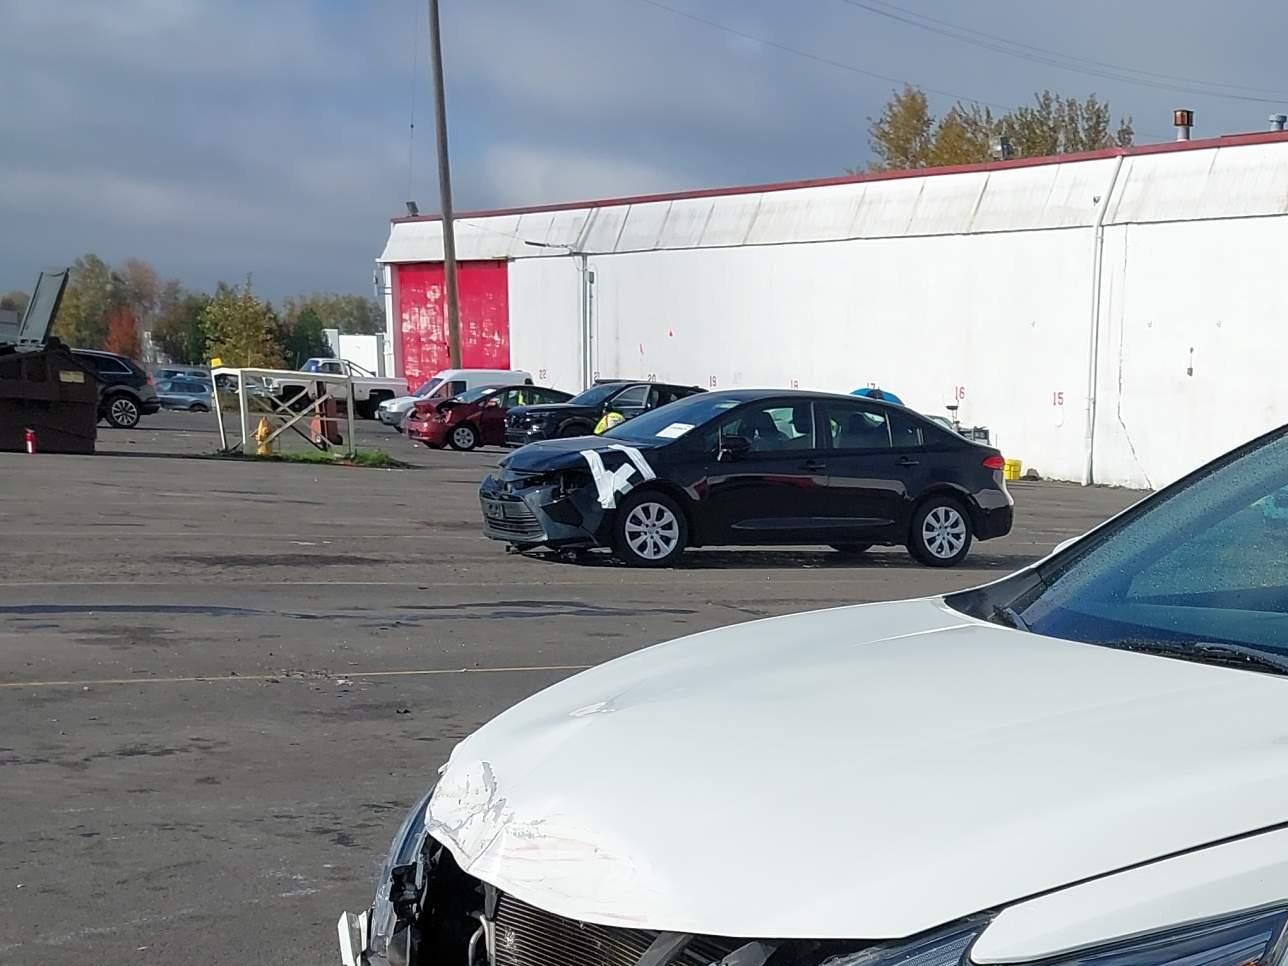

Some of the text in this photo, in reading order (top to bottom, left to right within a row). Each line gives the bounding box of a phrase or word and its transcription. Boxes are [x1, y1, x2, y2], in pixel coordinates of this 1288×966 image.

[709, 375, 717, 387] 19
[955, 385, 965, 400] 16
[1052, 391, 1064, 406] 15
